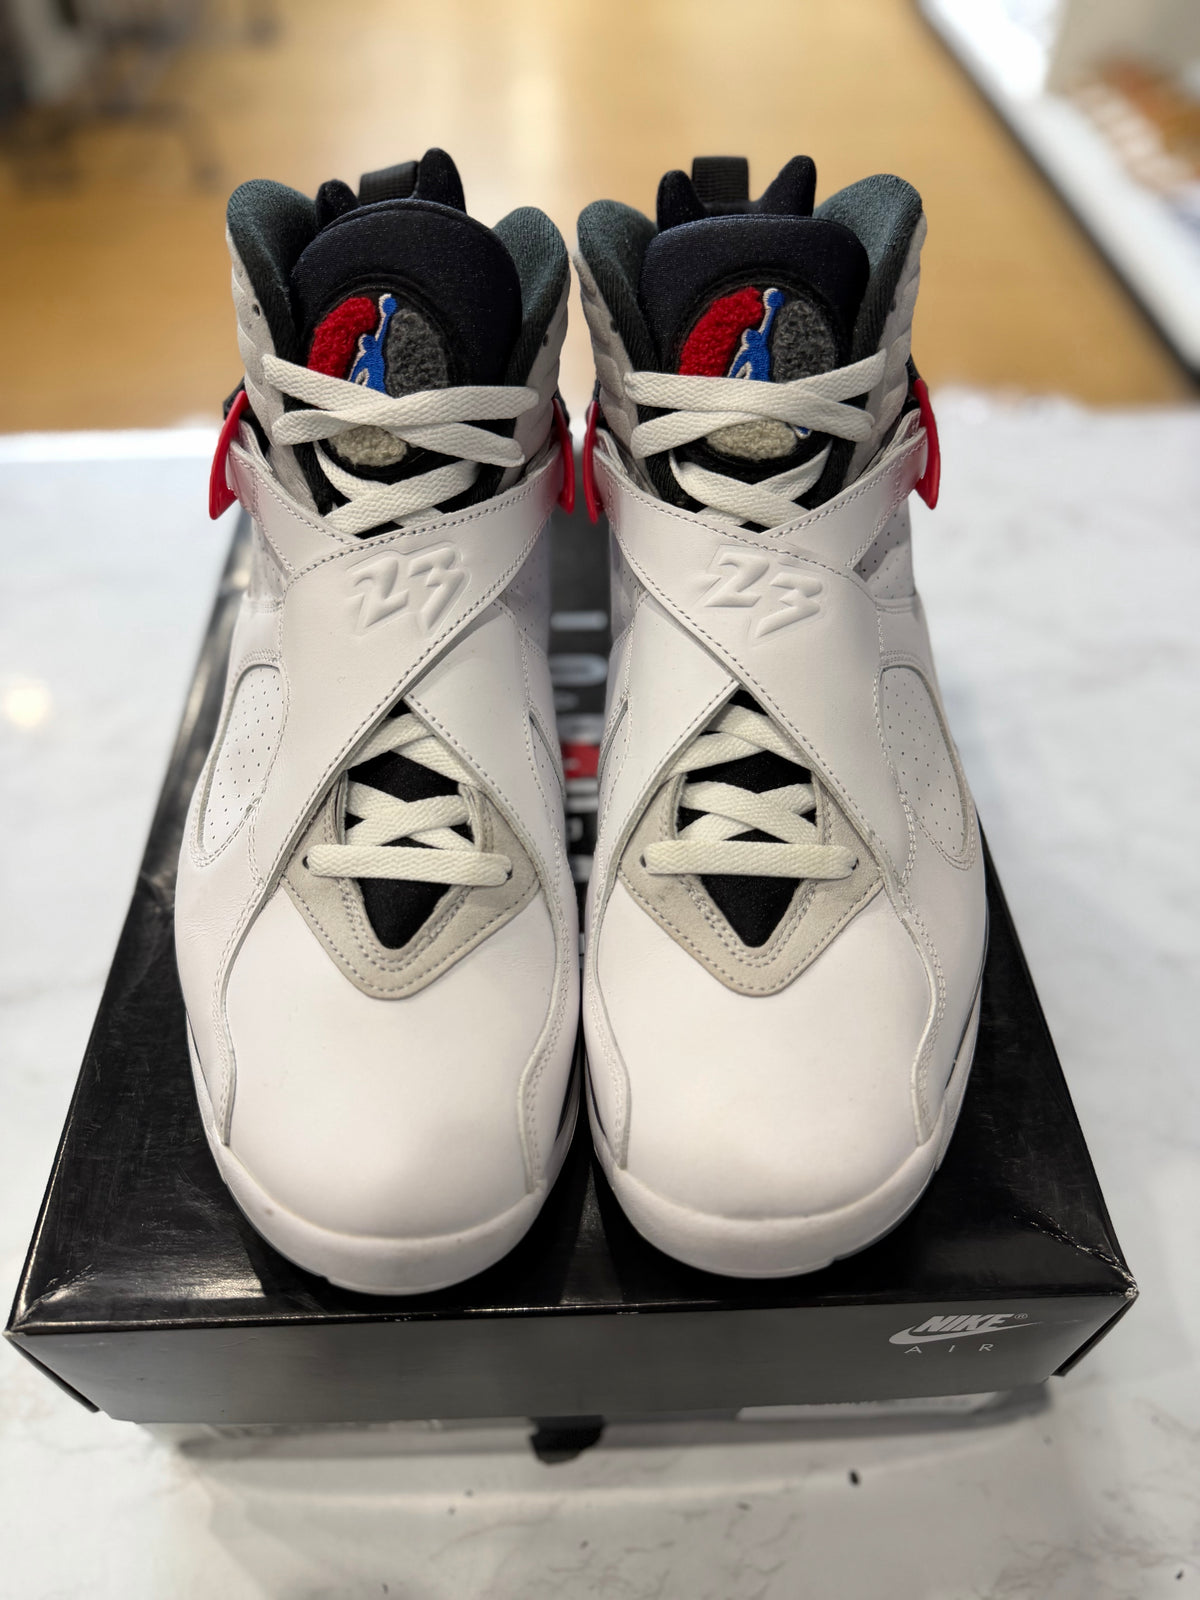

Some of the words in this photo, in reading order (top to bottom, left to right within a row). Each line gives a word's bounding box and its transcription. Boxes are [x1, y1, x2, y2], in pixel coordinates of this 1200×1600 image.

[350, 547, 466, 630] 23
[703, 552, 823, 638] 23
[904, 1343, 994, 1354] AIR
[914, 1313, 1014, 1333] NIKE
